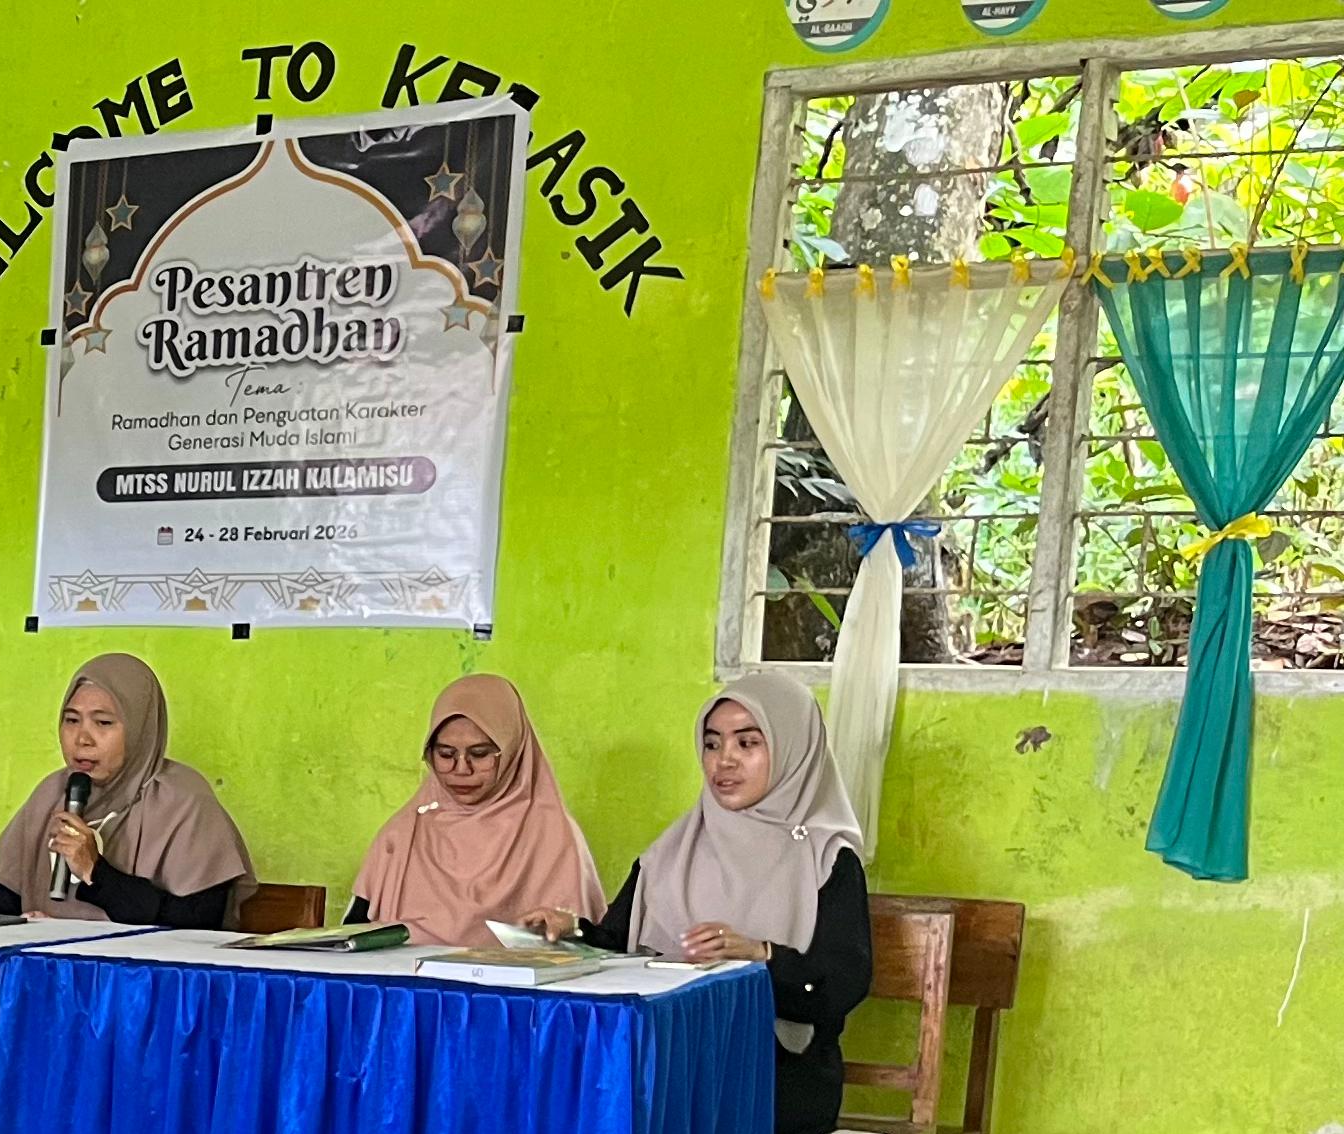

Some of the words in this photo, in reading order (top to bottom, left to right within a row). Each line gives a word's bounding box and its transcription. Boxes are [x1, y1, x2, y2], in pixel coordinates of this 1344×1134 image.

[241, 41, 336, 102] TO
[381, 43, 686, 319] KEASIK
[155, 261, 393, 312] Pesantren
[142, 306, 401, 371] Ramadhan
[225, 365, 292, 407] Tema
[111, 411, 201, 431] Ramadhan
[205, 411, 238, 427] dan
[243, 405, 340, 428] Penguatan
[345, 402, 427, 420] Karakter
[168, 432, 244, 451] Generasi
[249, 430, 300, 447] Muda
[305, 429, 358, 446] Islami
[115, 473, 168, 496] MTSS
[173, 470, 236, 494] NURUL
[242, 468, 299, 492] IZZAH
[305, 464, 413, 490] KALAMISU
[184, 527, 205, 542] 24
[218, 526, 239, 542] 28
[243, 525, 310, 542] Februari
[313, 524, 359, 541] 2026
